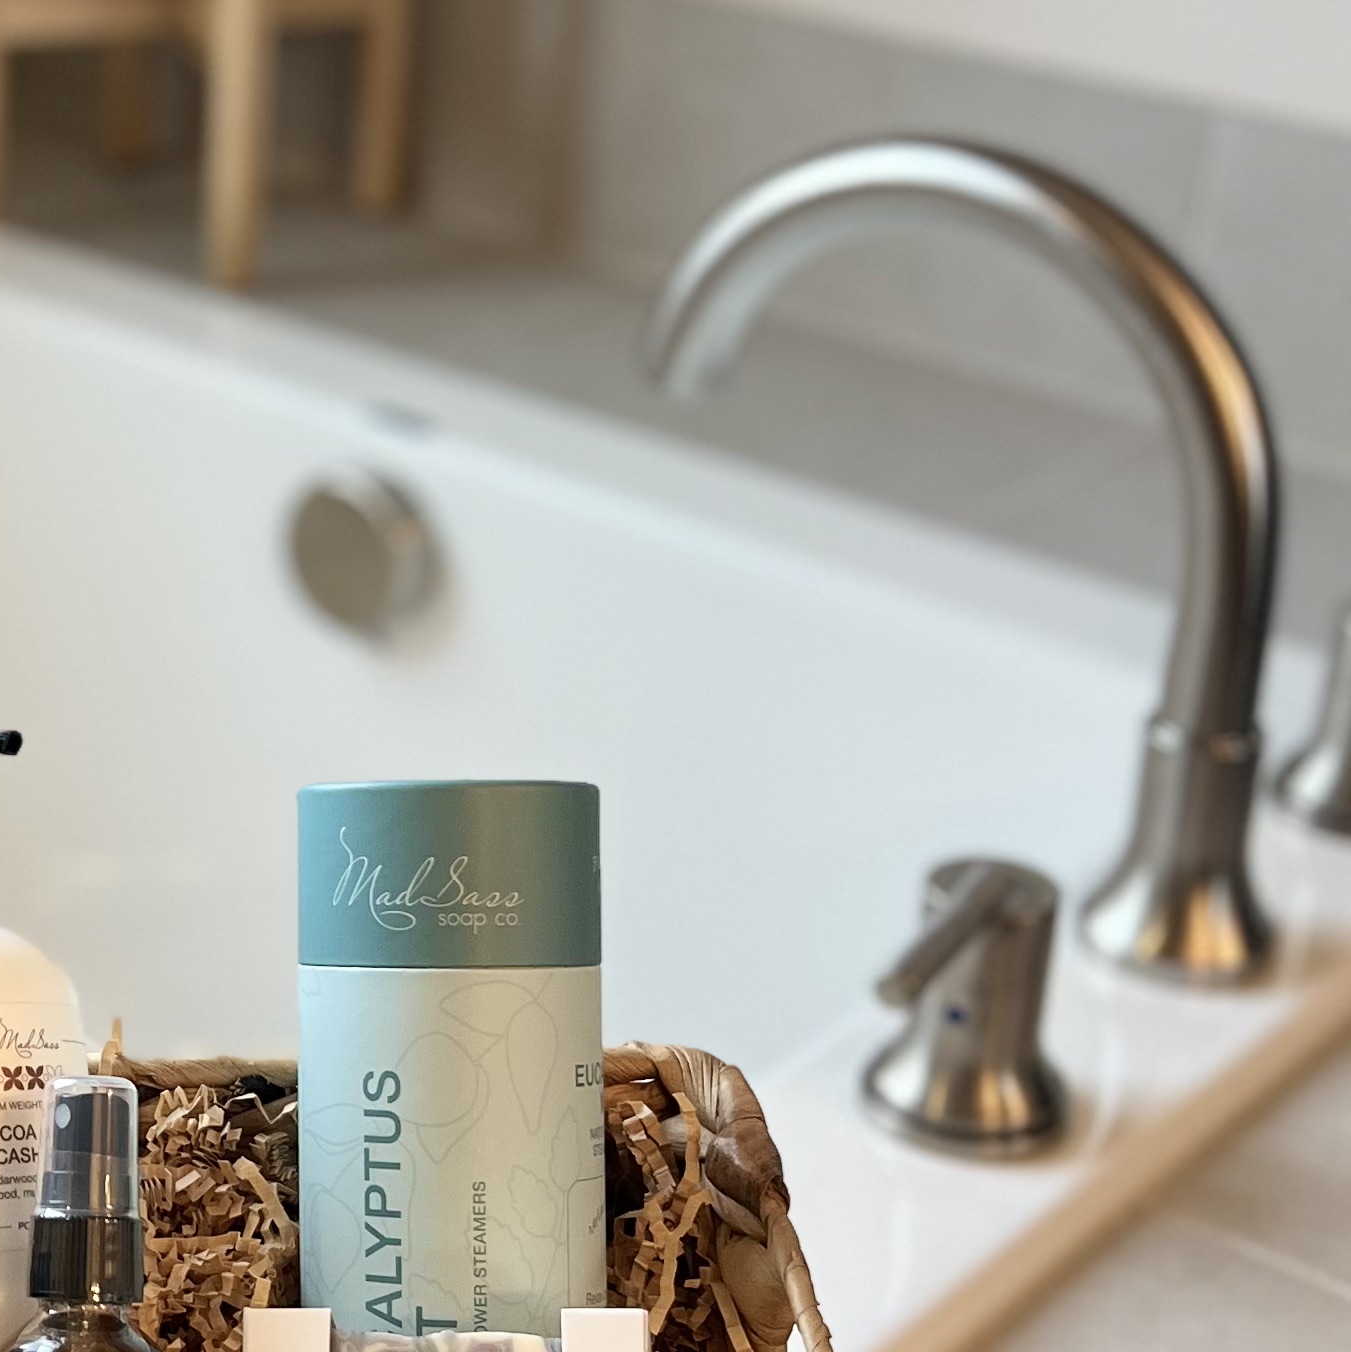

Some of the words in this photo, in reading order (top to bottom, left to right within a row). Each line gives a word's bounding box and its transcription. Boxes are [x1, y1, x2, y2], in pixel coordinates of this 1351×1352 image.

[438, 912, 486, 935] soap
[8, 1100, 43, 1111] WEIGHT
[362, 1069, 403, 1334] ALYPTUS
[472, 1180, 487, 1278] STEAMERS
